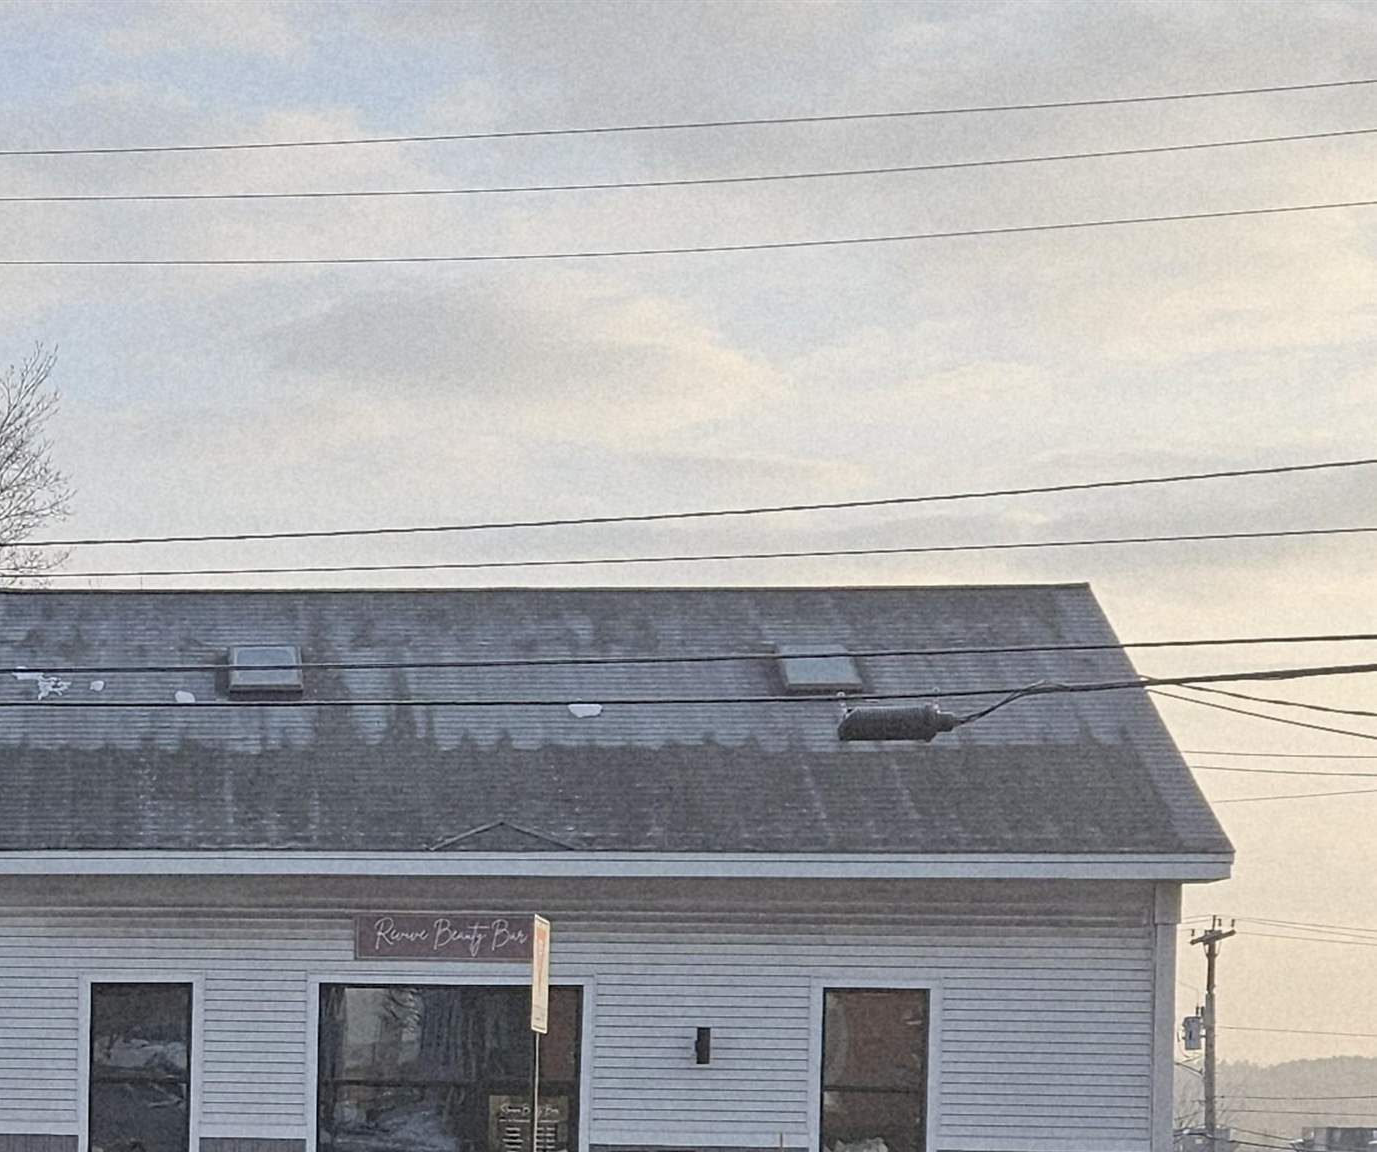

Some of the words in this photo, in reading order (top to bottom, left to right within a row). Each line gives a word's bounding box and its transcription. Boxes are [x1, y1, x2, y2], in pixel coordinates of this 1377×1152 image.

[374, 916, 429, 950] Revive
[433, 918, 490, 957] Beauty
[491, 918, 528, 951] Bar
